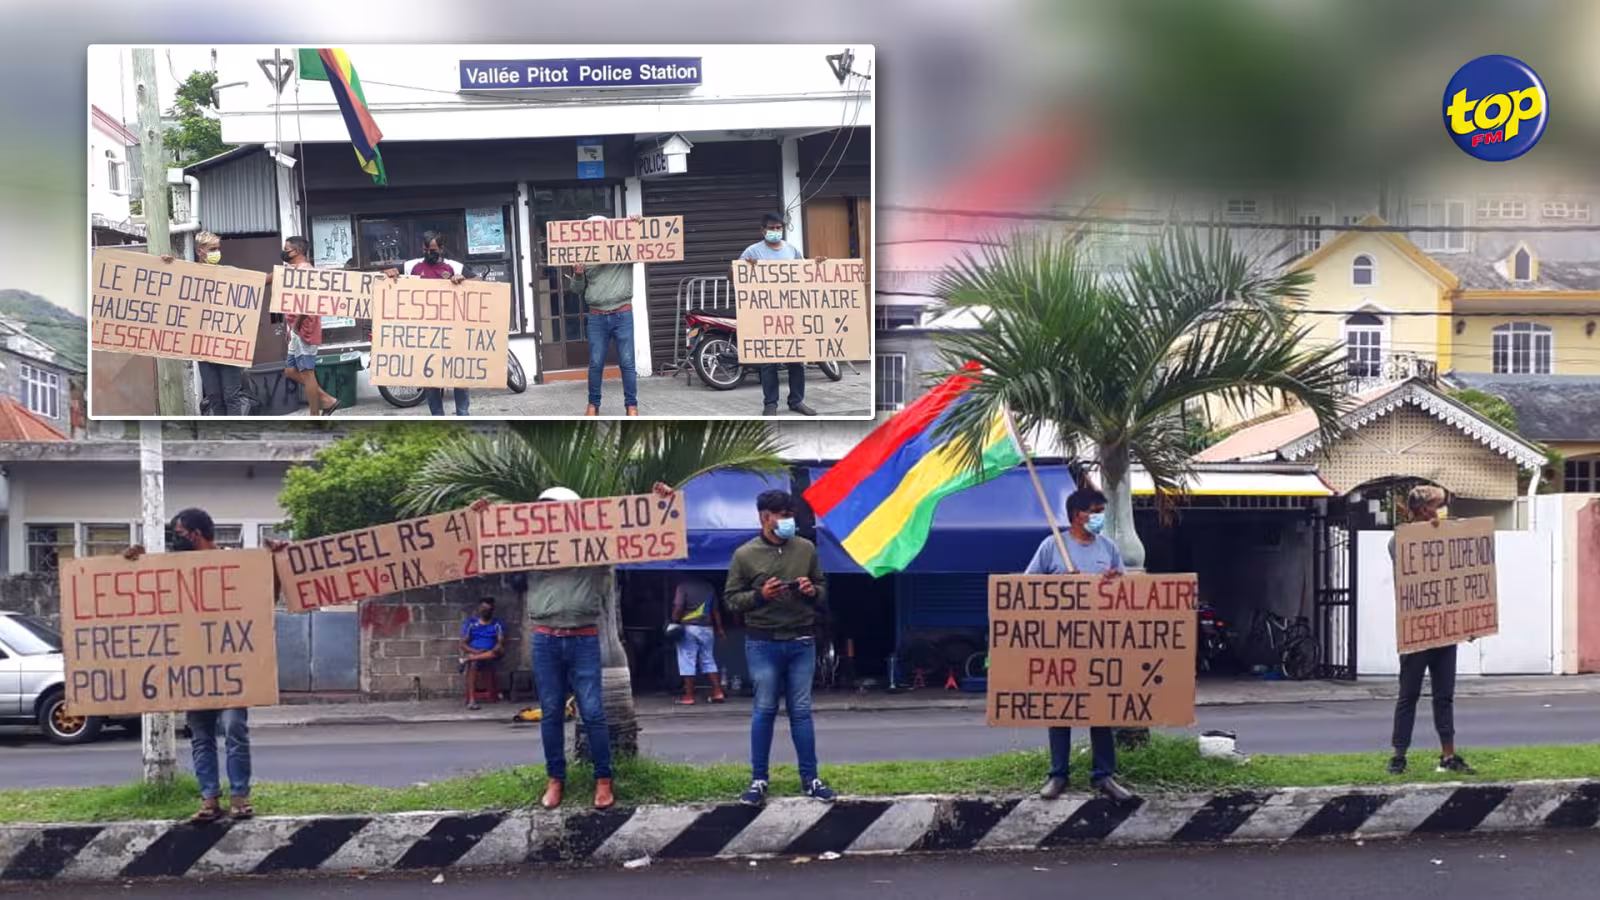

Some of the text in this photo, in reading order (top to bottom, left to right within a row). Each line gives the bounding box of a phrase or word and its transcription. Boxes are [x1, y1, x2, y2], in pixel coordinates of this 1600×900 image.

[466, 63, 697, 84] Vallée Pitot Police Station
[639, 153, 666, 175] POLICE
[638, 218, 660, 240] 10
[665, 217, 680, 239] %
[549, 245, 600, 264] FREEZE
[607, 244, 631, 261] TAX
[99, 262, 127, 291] LE
[133, 268, 172, 296] PEP
[282, 267, 352, 293] DIESEL
[738, 263, 800, 284] BAISSE
[738, 289, 861, 310] PARLMENTAIRE
[92, 294, 246, 335] HAUSSE DE PRIX
[763, 315, 795, 335] PAR
[834, 314, 849, 334] %
[190, 333, 252, 361] DIESEL
[380, 325, 496, 351] FREEZE TAX
[743, 338, 845, 359] FREEZE TAX
[376, 354, 488, 380] POU 6 MOIS
[619, 497, 650, 529] 10
[657, 493, 679, 526] %
[287, 511, 471, 576] DIESEL RS 41
[481, 540, 560, 570] FREEZE
[570, 536, 609, 564] TAX
[1401, 542, 1417, 576] LE
[1421, 539, 1445, 572] PEP
[995, 581, 1091, 611] BAISSE
[1400, 571, 1491, 612] HAUSSE DE PRIX
[75, 620, 254, 661] FREEZE TAX
[992, 620, 1186, 650] PARLMENTAIRE
[72, 663, 243, 702] POU 6 MOIS
[1029, 658, 1077, 687] PAR
[1141, 658, 1164, 687] %
[995, 692, 1153, 721] FREEZE TAX
